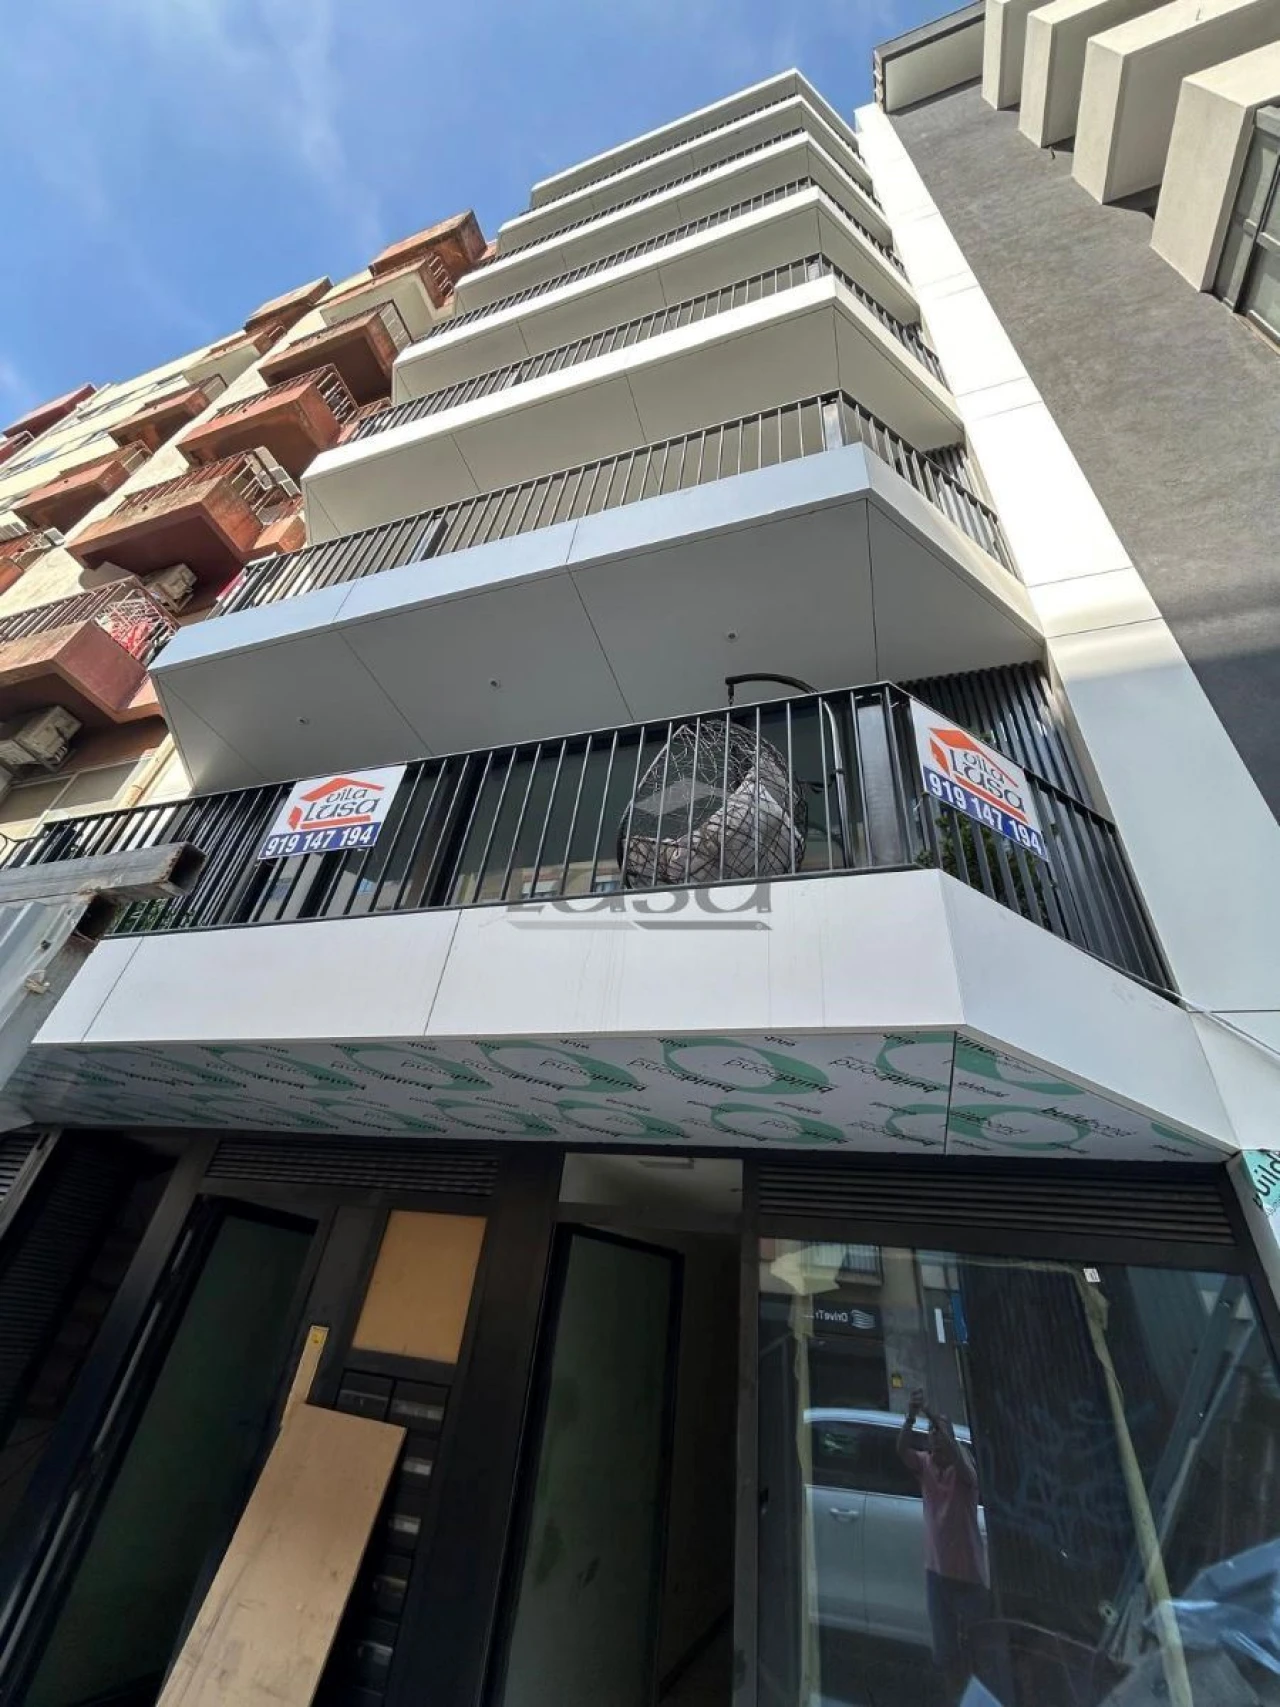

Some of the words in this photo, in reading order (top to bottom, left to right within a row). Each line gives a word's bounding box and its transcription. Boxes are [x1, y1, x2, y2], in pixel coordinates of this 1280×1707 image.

[929, 773, 967, 809] 919
[971, 797, 1004, 830] 147
[1008, 820, 1042, 855] 194
[265, 833, 300, 856] 919
[303, 830, 335, 852] 147
[340, 825, 371, 846] 194
[723, 1060, 834, 1093] buildbond
[829, 1059, 940, 1093] buildbond
